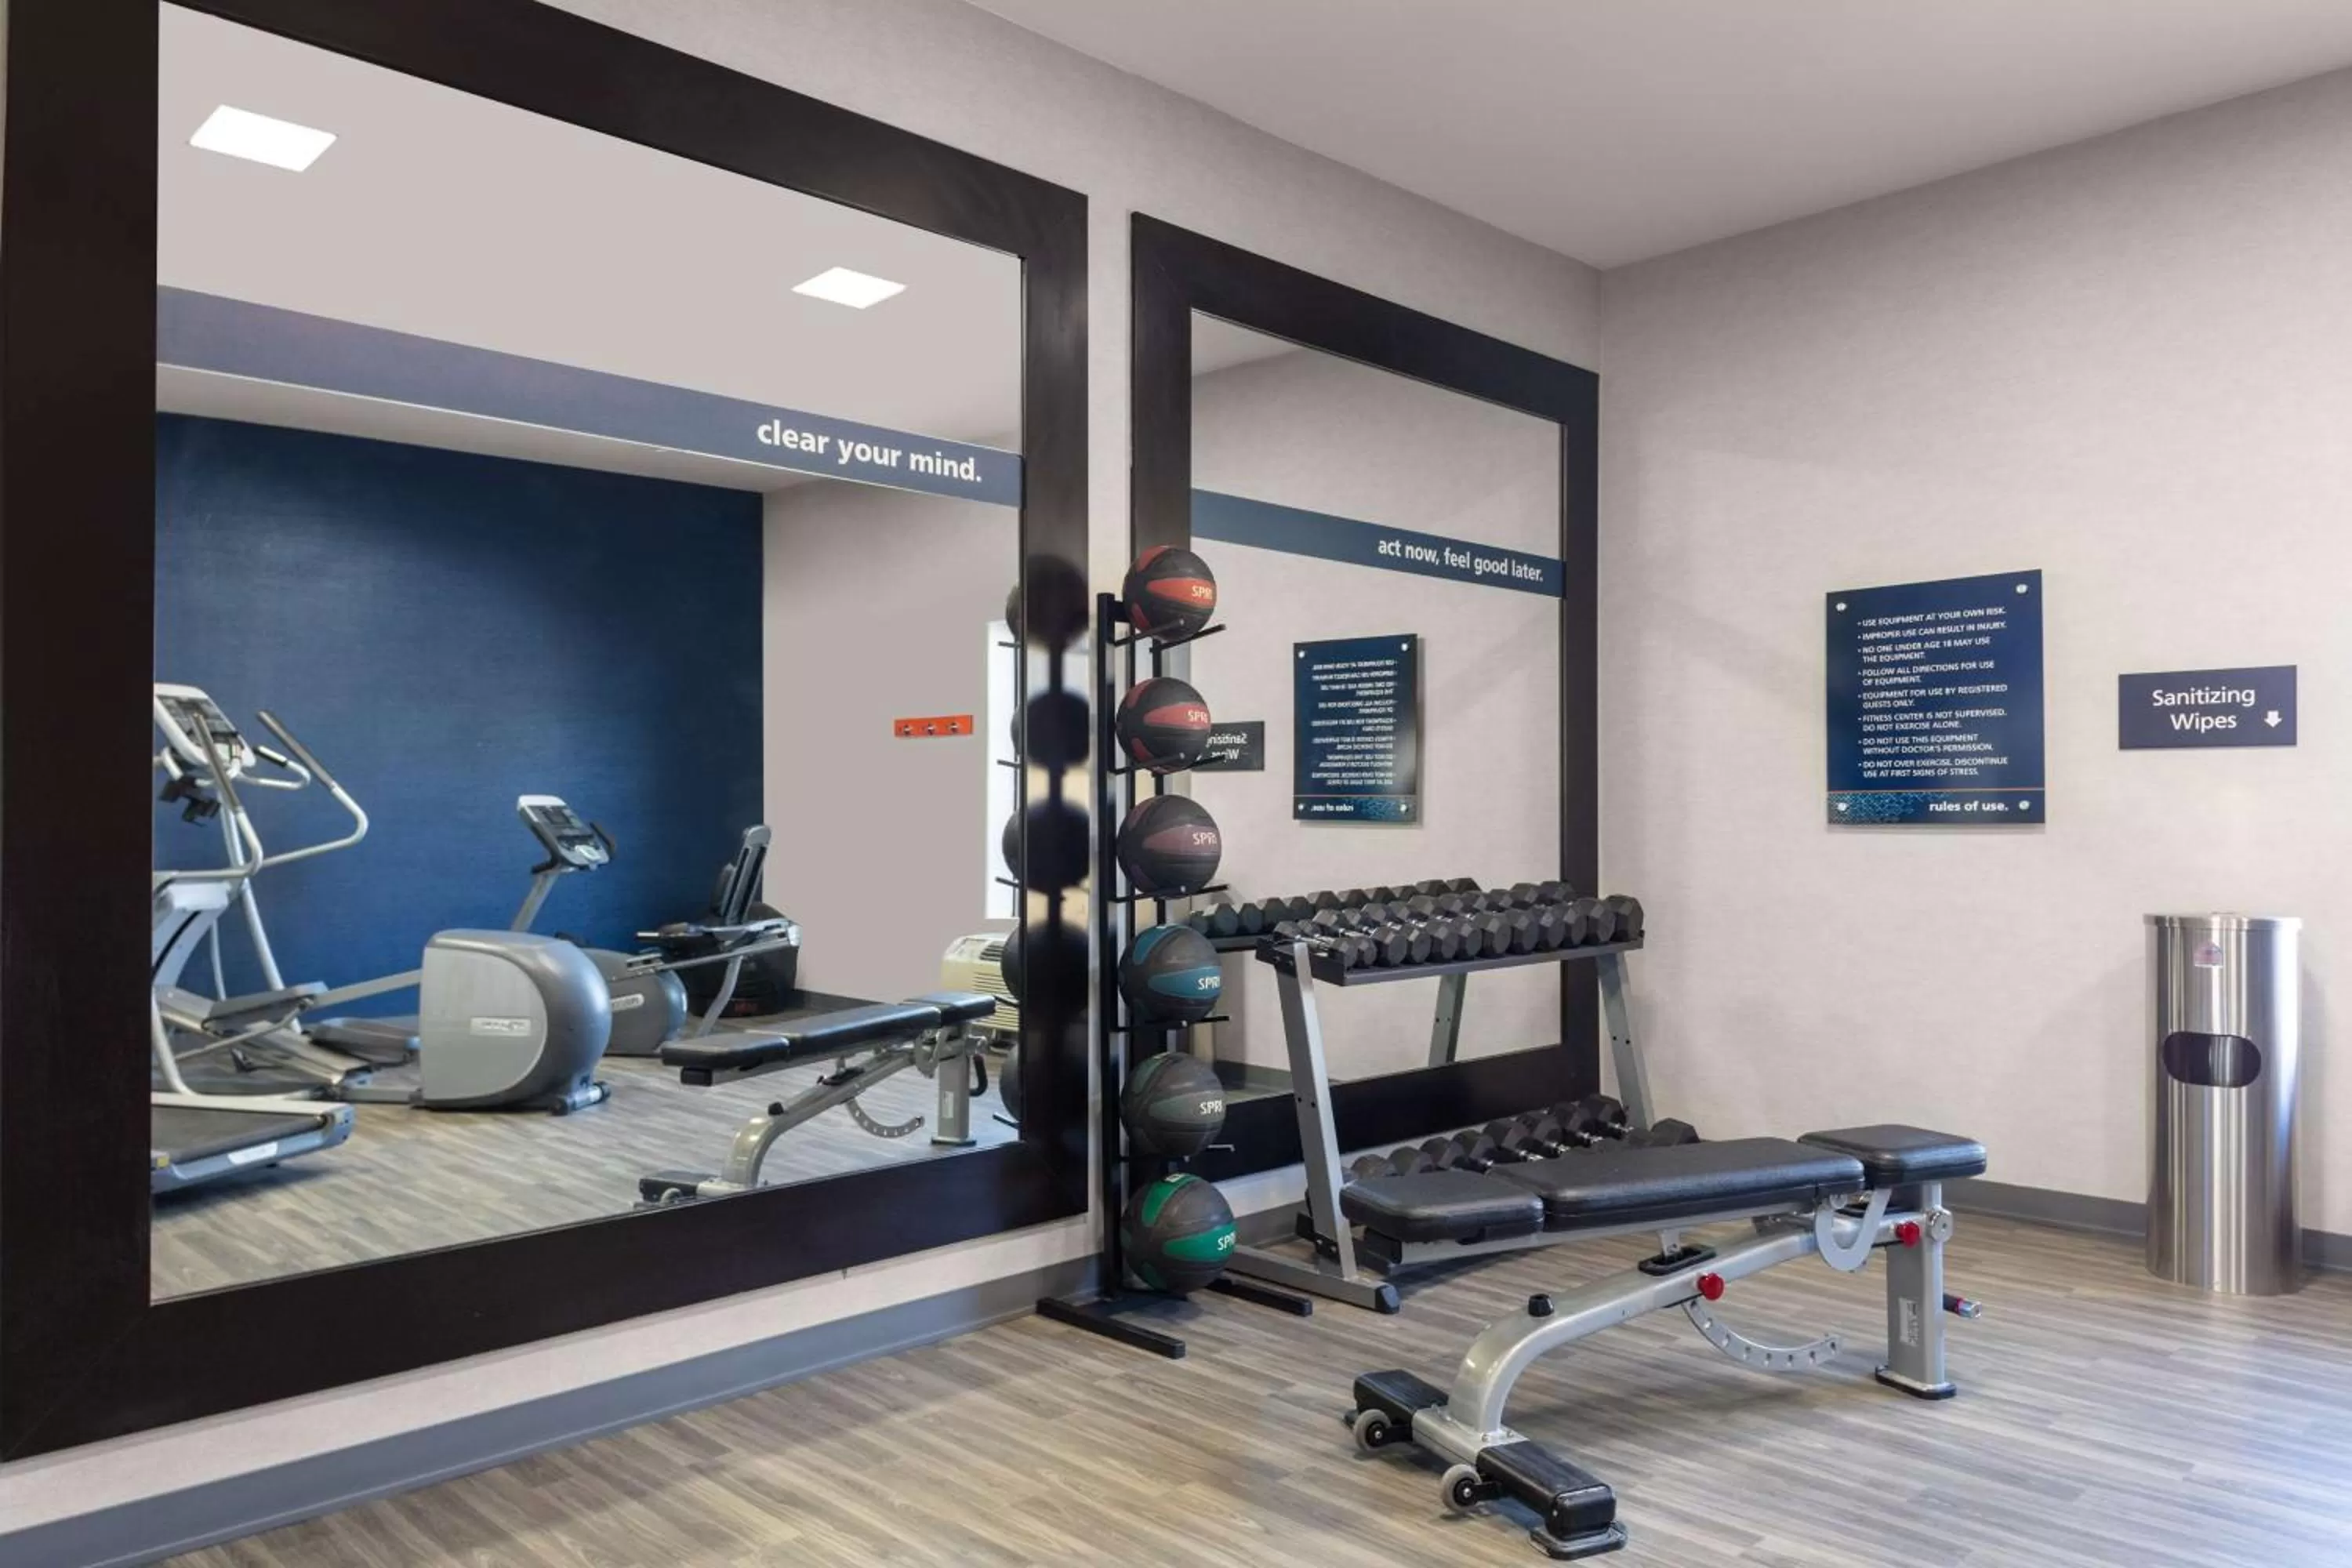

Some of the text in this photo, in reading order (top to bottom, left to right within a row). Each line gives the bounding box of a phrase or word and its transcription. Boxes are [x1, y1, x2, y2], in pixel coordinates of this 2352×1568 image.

[757, 419, 982, 483] clear your mind.
[1378, 539, 1544, 582] act now, feel good later.
[1878, 614, 1924, 625] EQUIPMENT
[1938, 610, 1961, 619] YOUR
[1963, 608, 1984, 617] OWN
[1987, 606, 2006, 615] RISK.
[1863, 631, 1900, 641] IMPROPER
[1918, 627, 1935, 636] CAN
[1937, 624, 1964, 633] RESULT
[1976, 621, 2007, 630] INJURY.
[1895, 642, 1922, 651] UNDER
[1954, 637, 1973, 647] MAY
[1879, 652, 1926, 662] EQUIPMENT.
[1863, 668, 1894, 677] FOLLOW
[1912, 662, 1958, 673] DIRECTIONS
[1961, 661, 1976, 670] FOR
[1979, 660, 1994, 669] USE
[1875, 675, 1922, 686] EQUIPMENT.
[1863, 684, 2008, 700] EQUIPMENT FOR USE BY REGISTERED
[2152, 686, 2256, 707] Sanitizing
[1863, 700, 1891, 709] GUESTS
[1894, 713, 1922, 721] CENTER
[1935, 710, 1953, 719] NOT
[1955, 708, 2007, 718] SUPERVISED.
[1895, 721, 1930, 731] EXERCISE
[2170, 713, 2237, 733] Wipes
[1930, 733, 1979, 743] EQUIPMENT
[1891, 768, 1911, 777] FIRST
[1929, 800, 2009, 811] rules of use.
